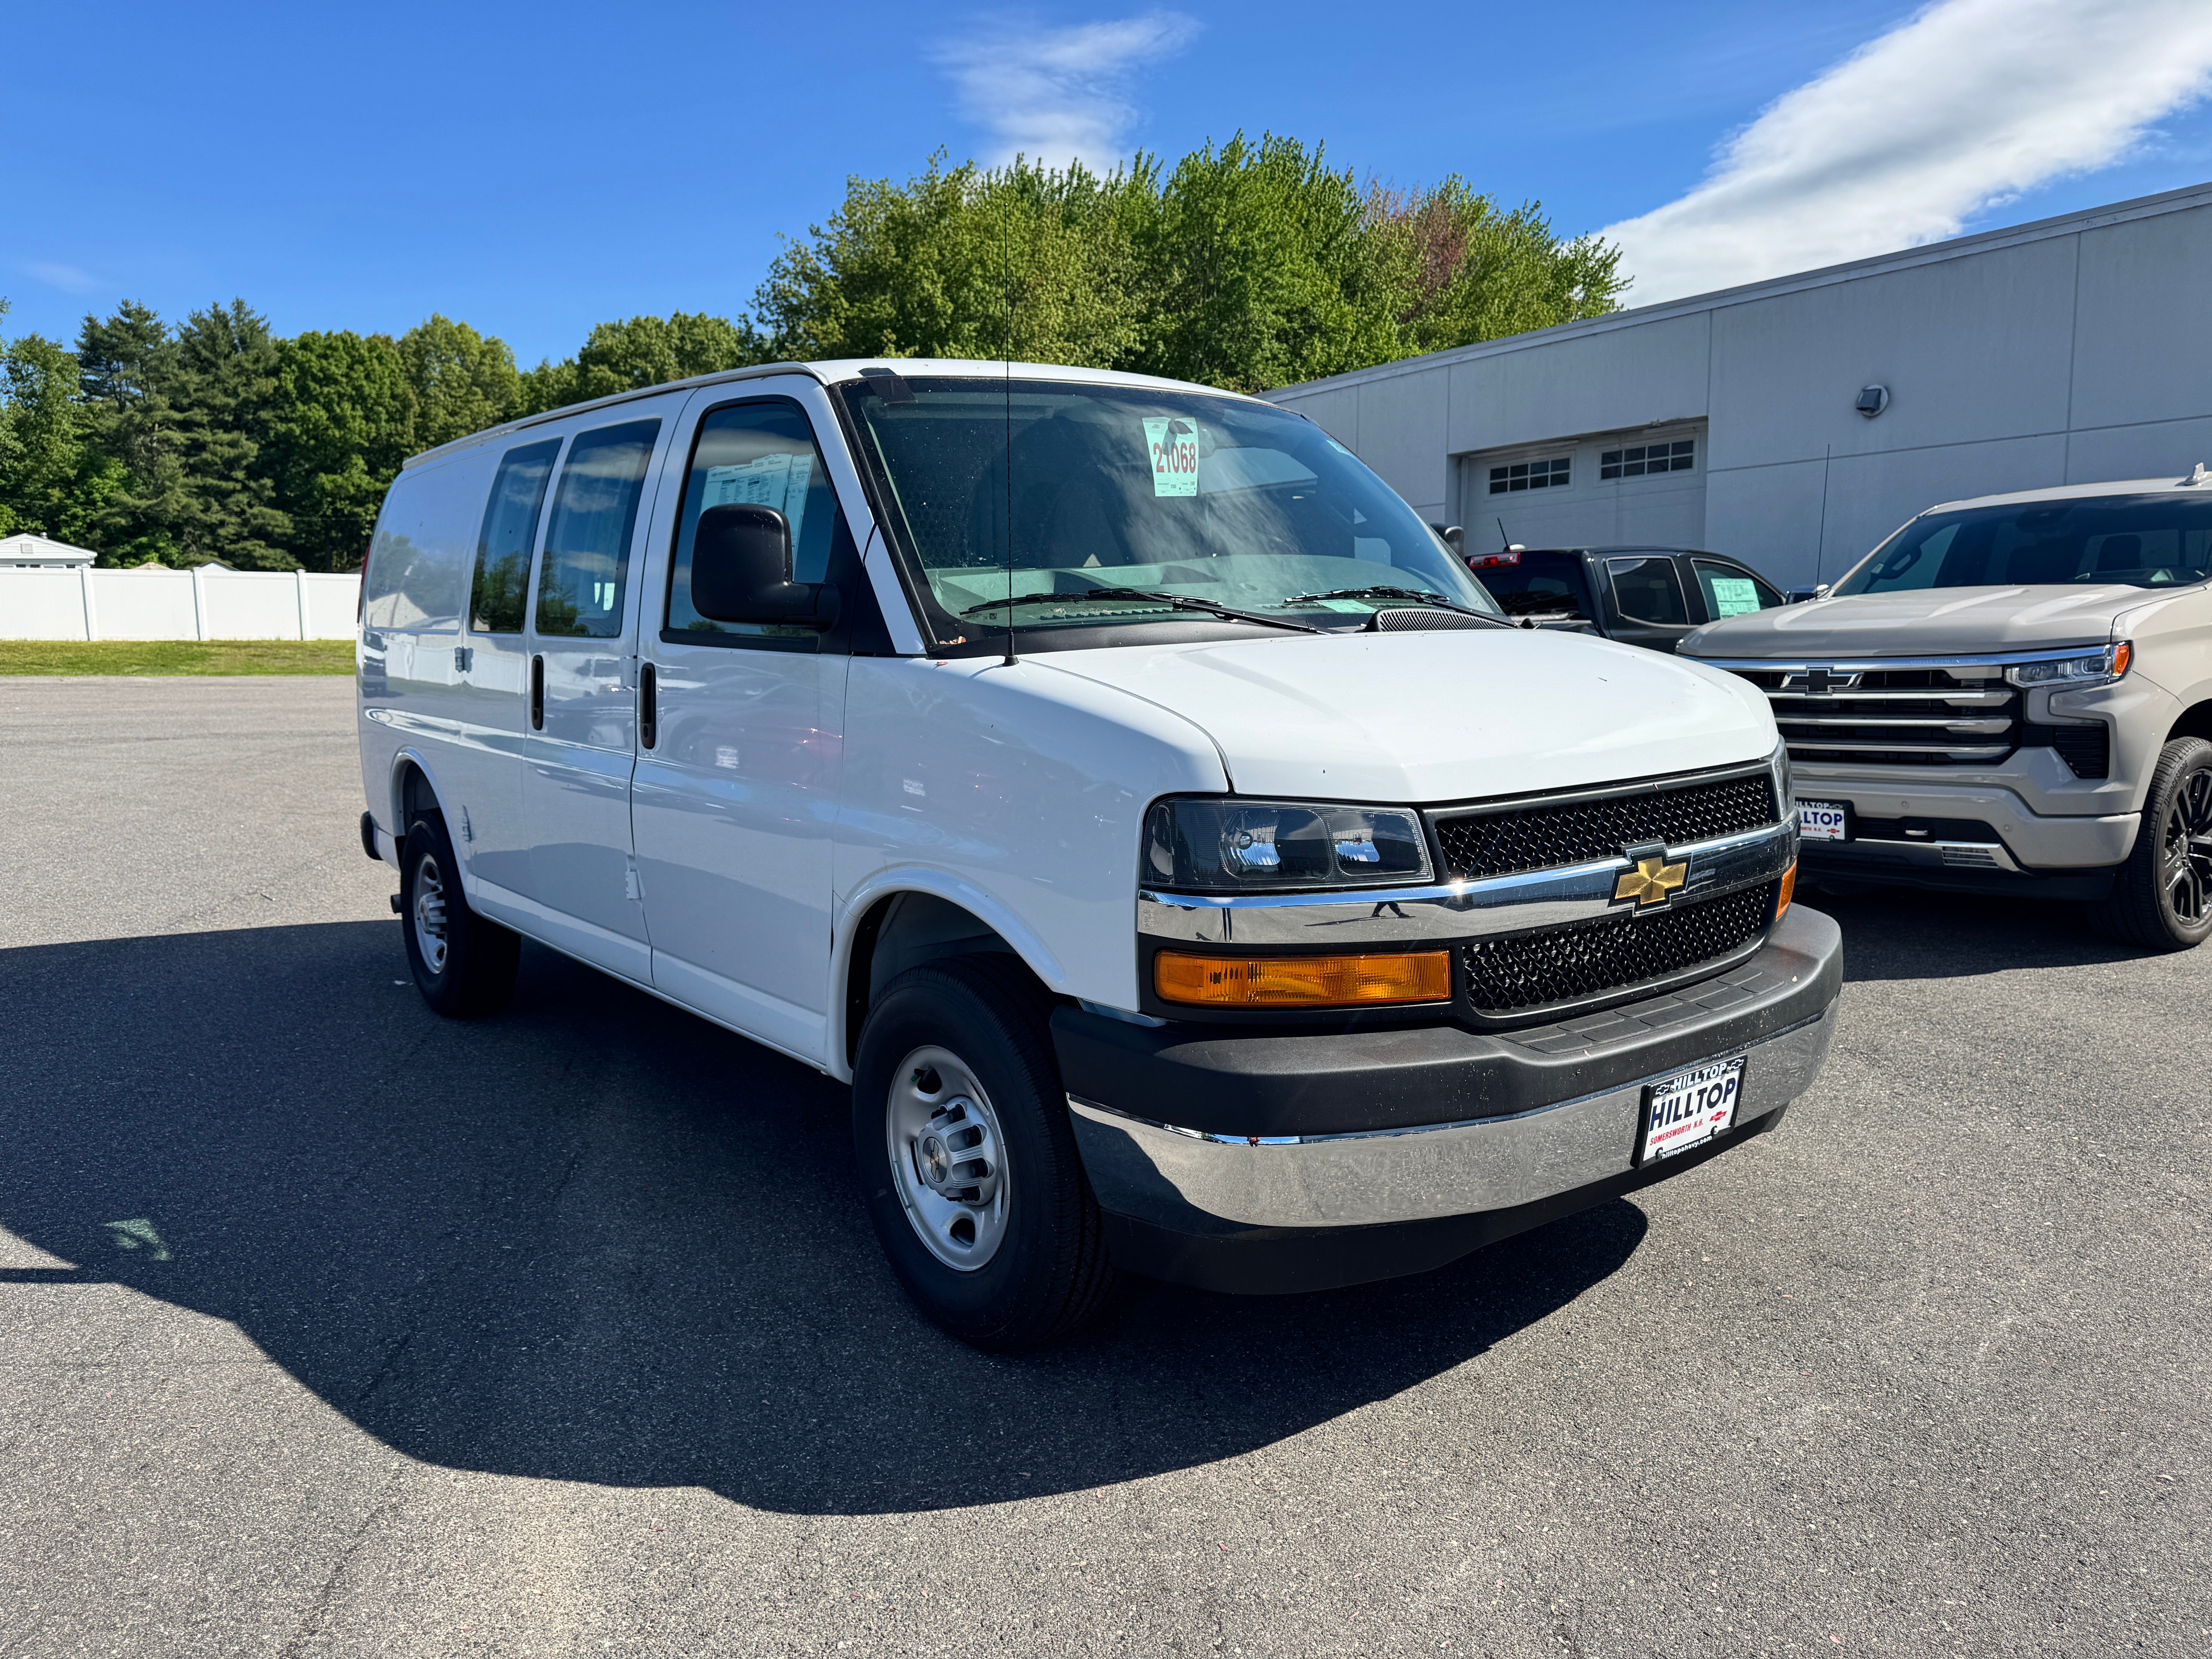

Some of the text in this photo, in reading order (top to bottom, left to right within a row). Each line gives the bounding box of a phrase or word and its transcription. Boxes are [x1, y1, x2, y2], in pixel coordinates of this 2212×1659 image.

[1153, 442, 1196, 474] 21068
[1796, 801, 1829, 809] ILLTOP
[1801, 811, 1843, 826] LTOP
[1673, 1062, 1727, 1091] HILLTOP
[1649, 1077, 1736, 1132] HILLTOP
[1649, 1118, 1704, 1146] SOMERSWORTH N.H.
